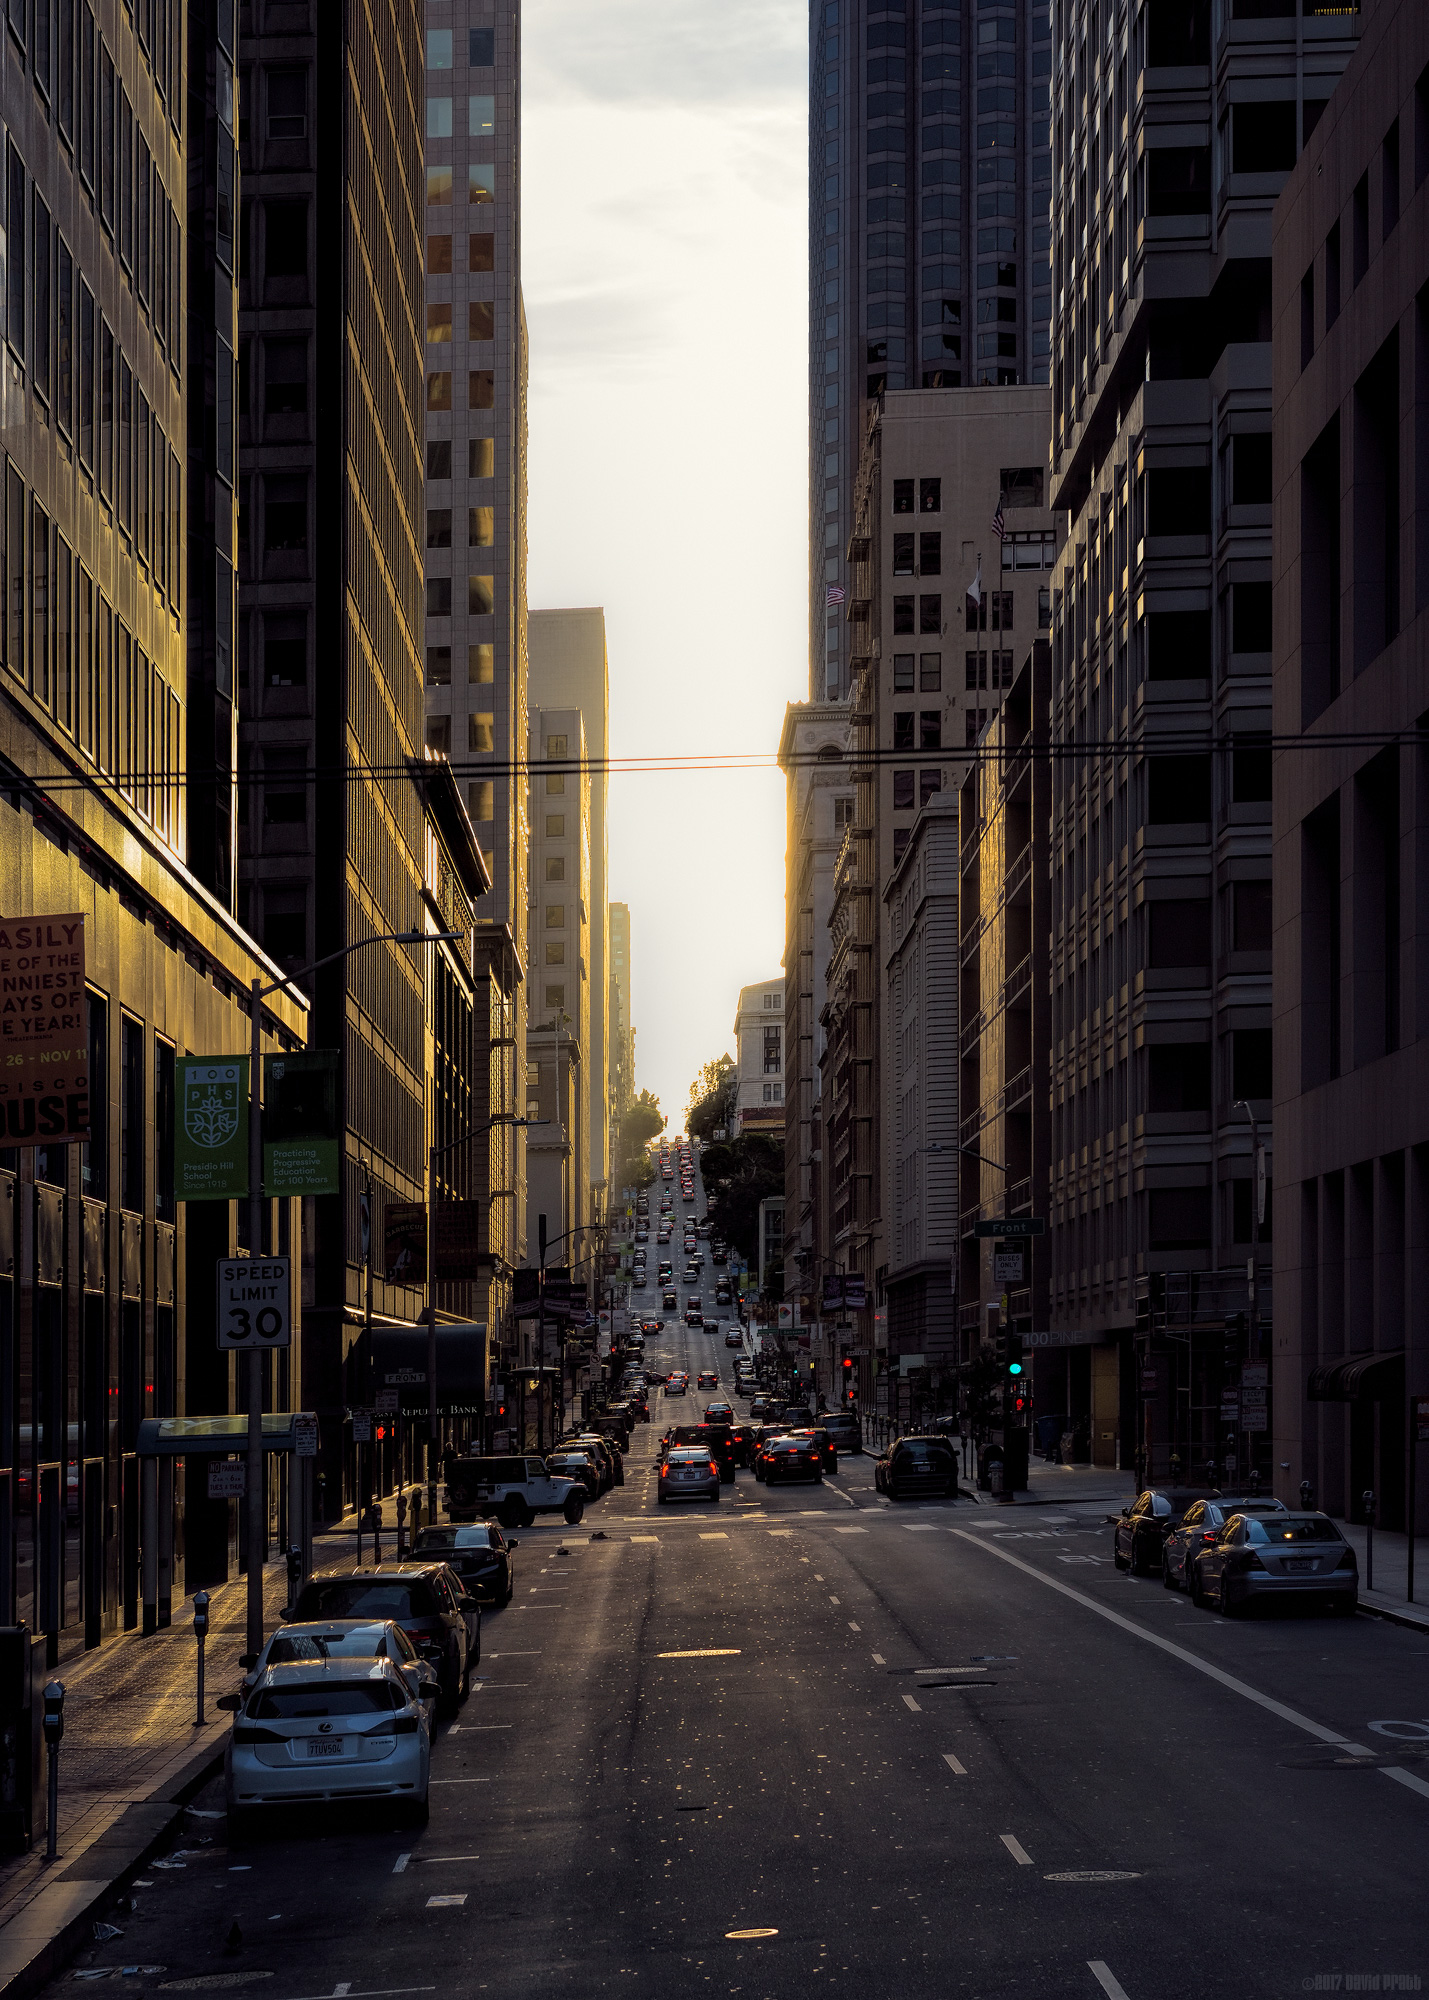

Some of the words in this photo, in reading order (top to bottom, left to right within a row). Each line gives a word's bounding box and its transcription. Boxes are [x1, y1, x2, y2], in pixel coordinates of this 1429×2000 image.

[17, 956, 41, 970] OF
[47, 952, 80, 967] THE
[3, 971, 80, 992] NNIEST
[0, 994, 43, 1014] AYS
[51, 991, 81, 1009] OF
[20, 1013, 81, 1033] YEAR!
[6, 1053, 24, 1067] 26
[40, 1049, 71, 1064] NOV
[75, 1048, 88, 1060] 11
[191, 1069, 235, 1080] 100
[273, 1149, 316, 1159] Practicing
[183, 1162, 218, 1171] Presidio
[219, 1161, 234, 1170] Hill
[273, 1157, 321, 1168] Progressive
[183, 1171, 212, 1180] School
[273, 1167, 316, 1177] Education
[183, 1181, 205, 1189] Since
[207, 1179, 227, 1188] 1918
[273, 1178, 286, 1186] for
[288, 1176, 304, 1185] 100
[305, 1175, 328, 1185] Years
[385, 1223, 426, 1239] BARBECUE
[992, 1222, 1027, 1233] Front
[998, 1254, 1020, 1262] BUSES
[224, 1265, 285, 1281] SPEED
[230, 1286, 278, 1301] LIMIT
[226, 1306, 282, 1340] 30
[388, 1373, 424, 1383] FRONT
[450, 1404, 478, 1415] BANK
[209, 1462, 220, 1473] NO
[221, 1464, 244, 1473] PARKING
[992, 1528, 1106, 1539] ONLY
[310, 1743, 341, 1755] 7TUV504
